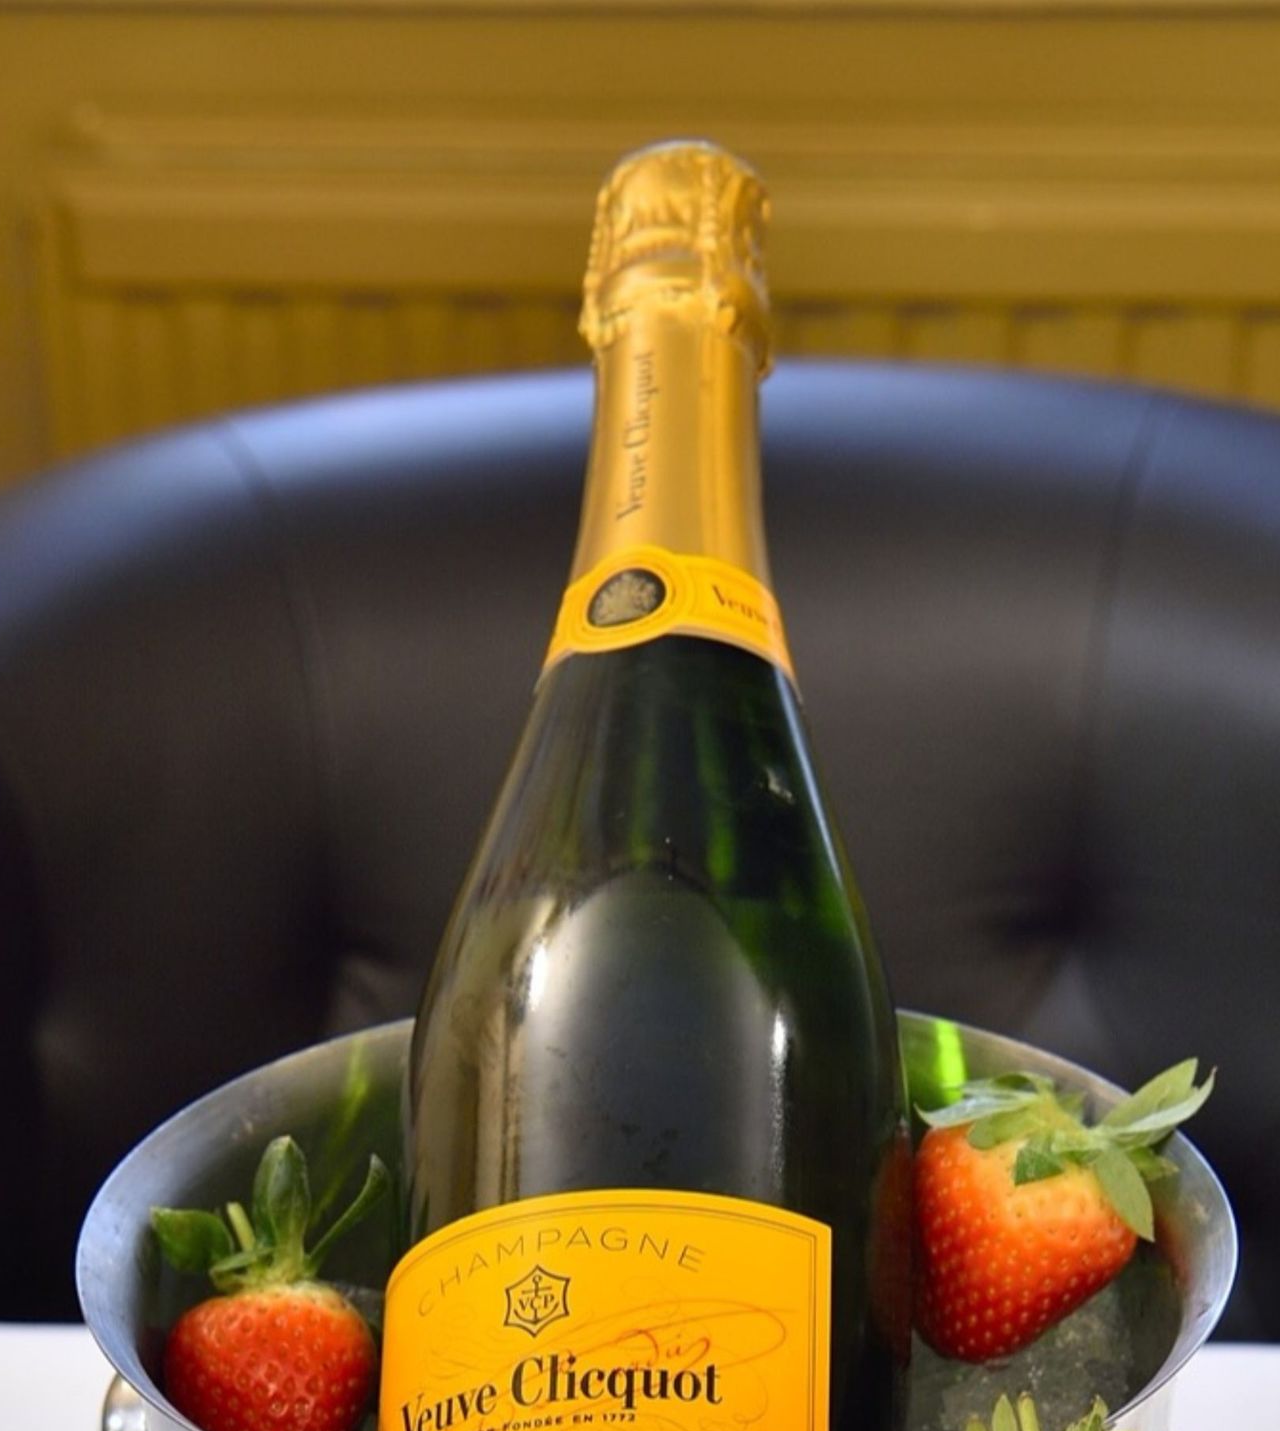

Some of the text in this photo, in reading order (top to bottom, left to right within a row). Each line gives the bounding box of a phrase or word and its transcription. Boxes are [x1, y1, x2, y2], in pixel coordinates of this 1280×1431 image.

[417, 1226, 707, 1317] CHAMPAGNE
[518, 1294, 555, 1311] VCP
[510, 1353, 723, 1409] Clicquot
[572, 1413, 594, 1423] EN
